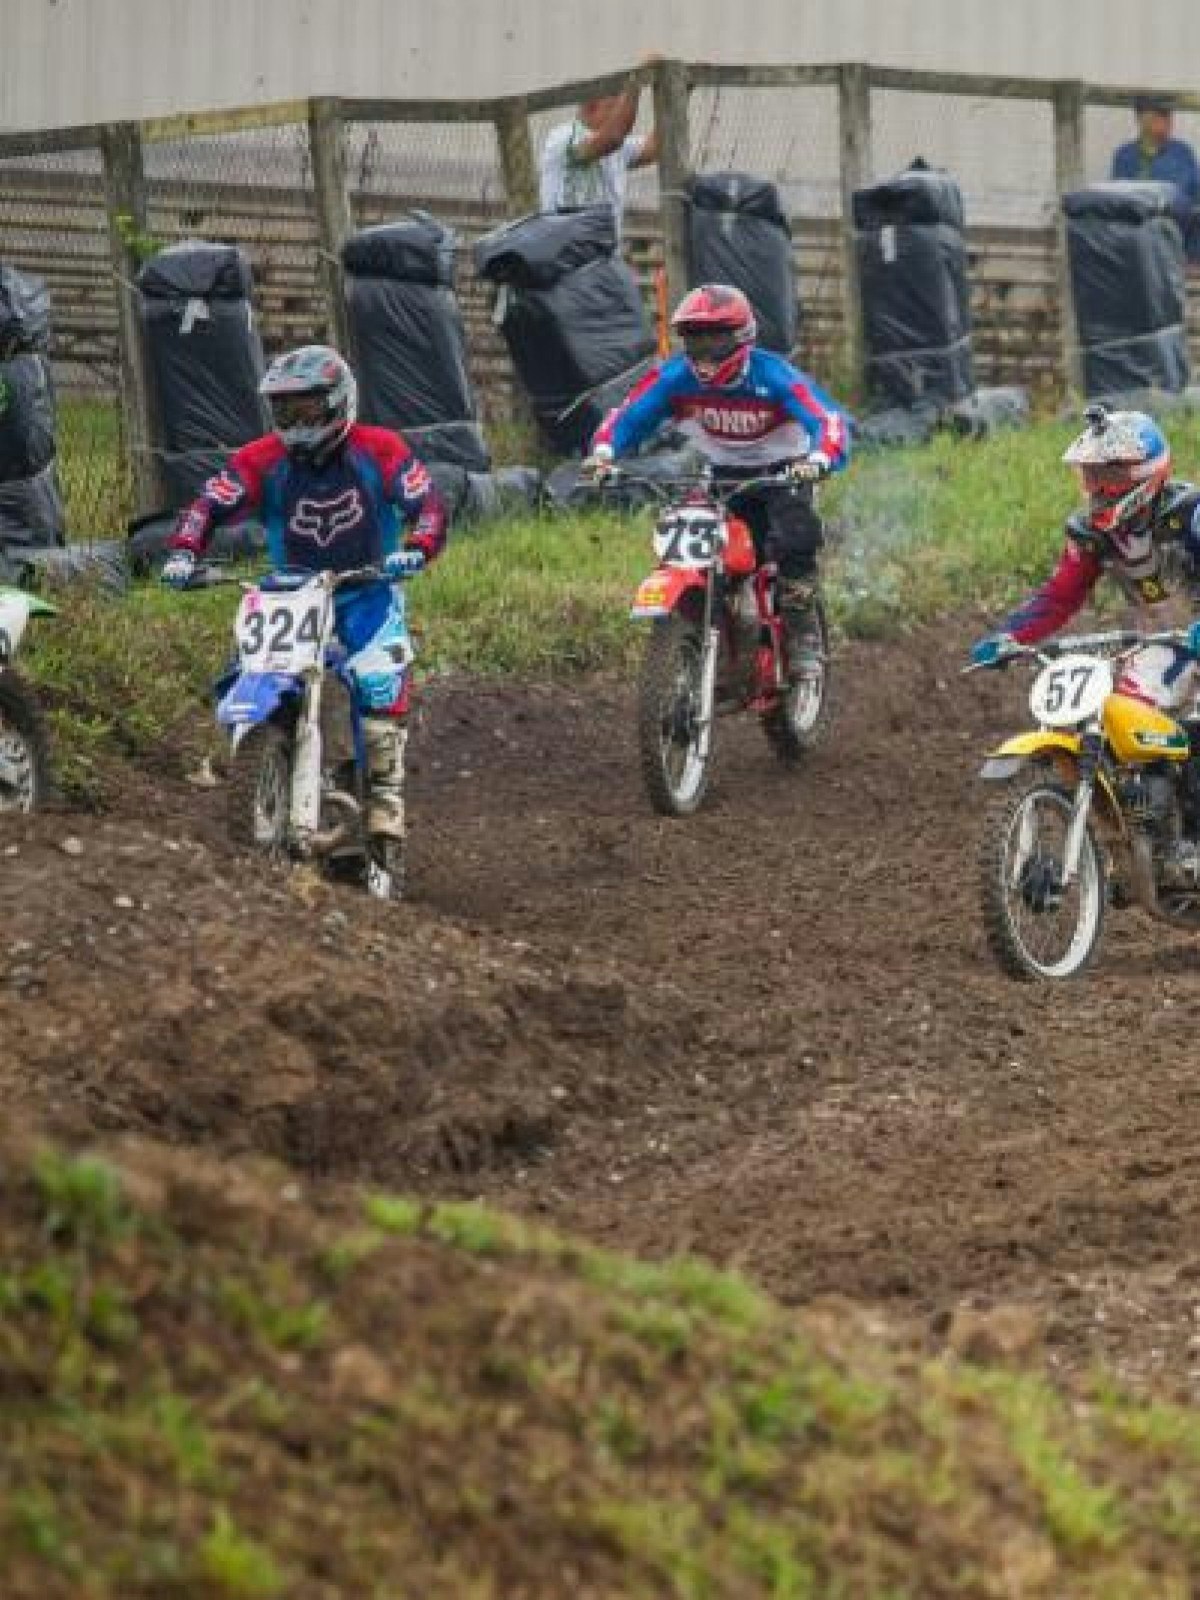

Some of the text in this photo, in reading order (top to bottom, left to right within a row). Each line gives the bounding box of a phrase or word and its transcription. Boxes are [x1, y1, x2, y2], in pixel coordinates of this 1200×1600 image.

[656, 516, 723, 562] 73
[241, 605, 321, 655] 324
[1046, 665, 1094, 713] 57
